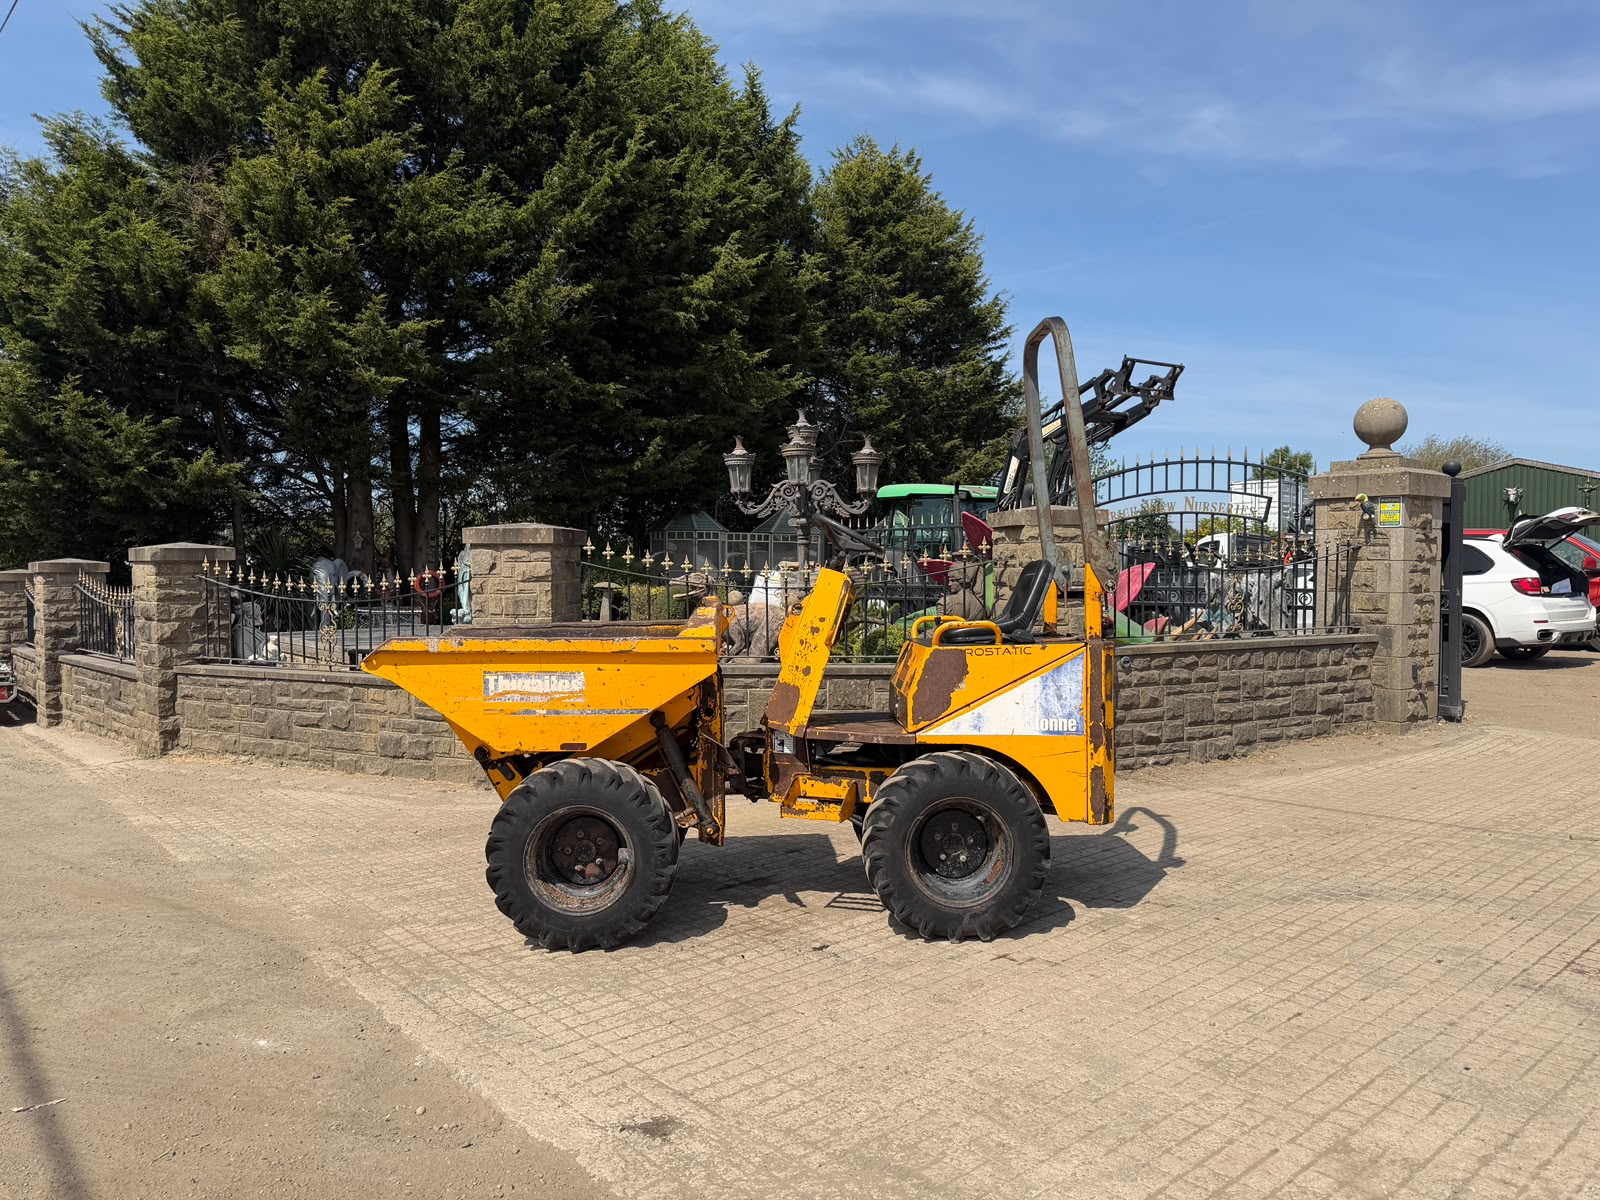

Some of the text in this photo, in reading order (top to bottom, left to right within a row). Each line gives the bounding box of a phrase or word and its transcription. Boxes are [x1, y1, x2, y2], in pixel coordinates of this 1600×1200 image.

[1145, 499, 1176, 513] VIEW
[1184, 496, 1258, 516] NURSERIES
[1032, 718, 1077, 732] onne
